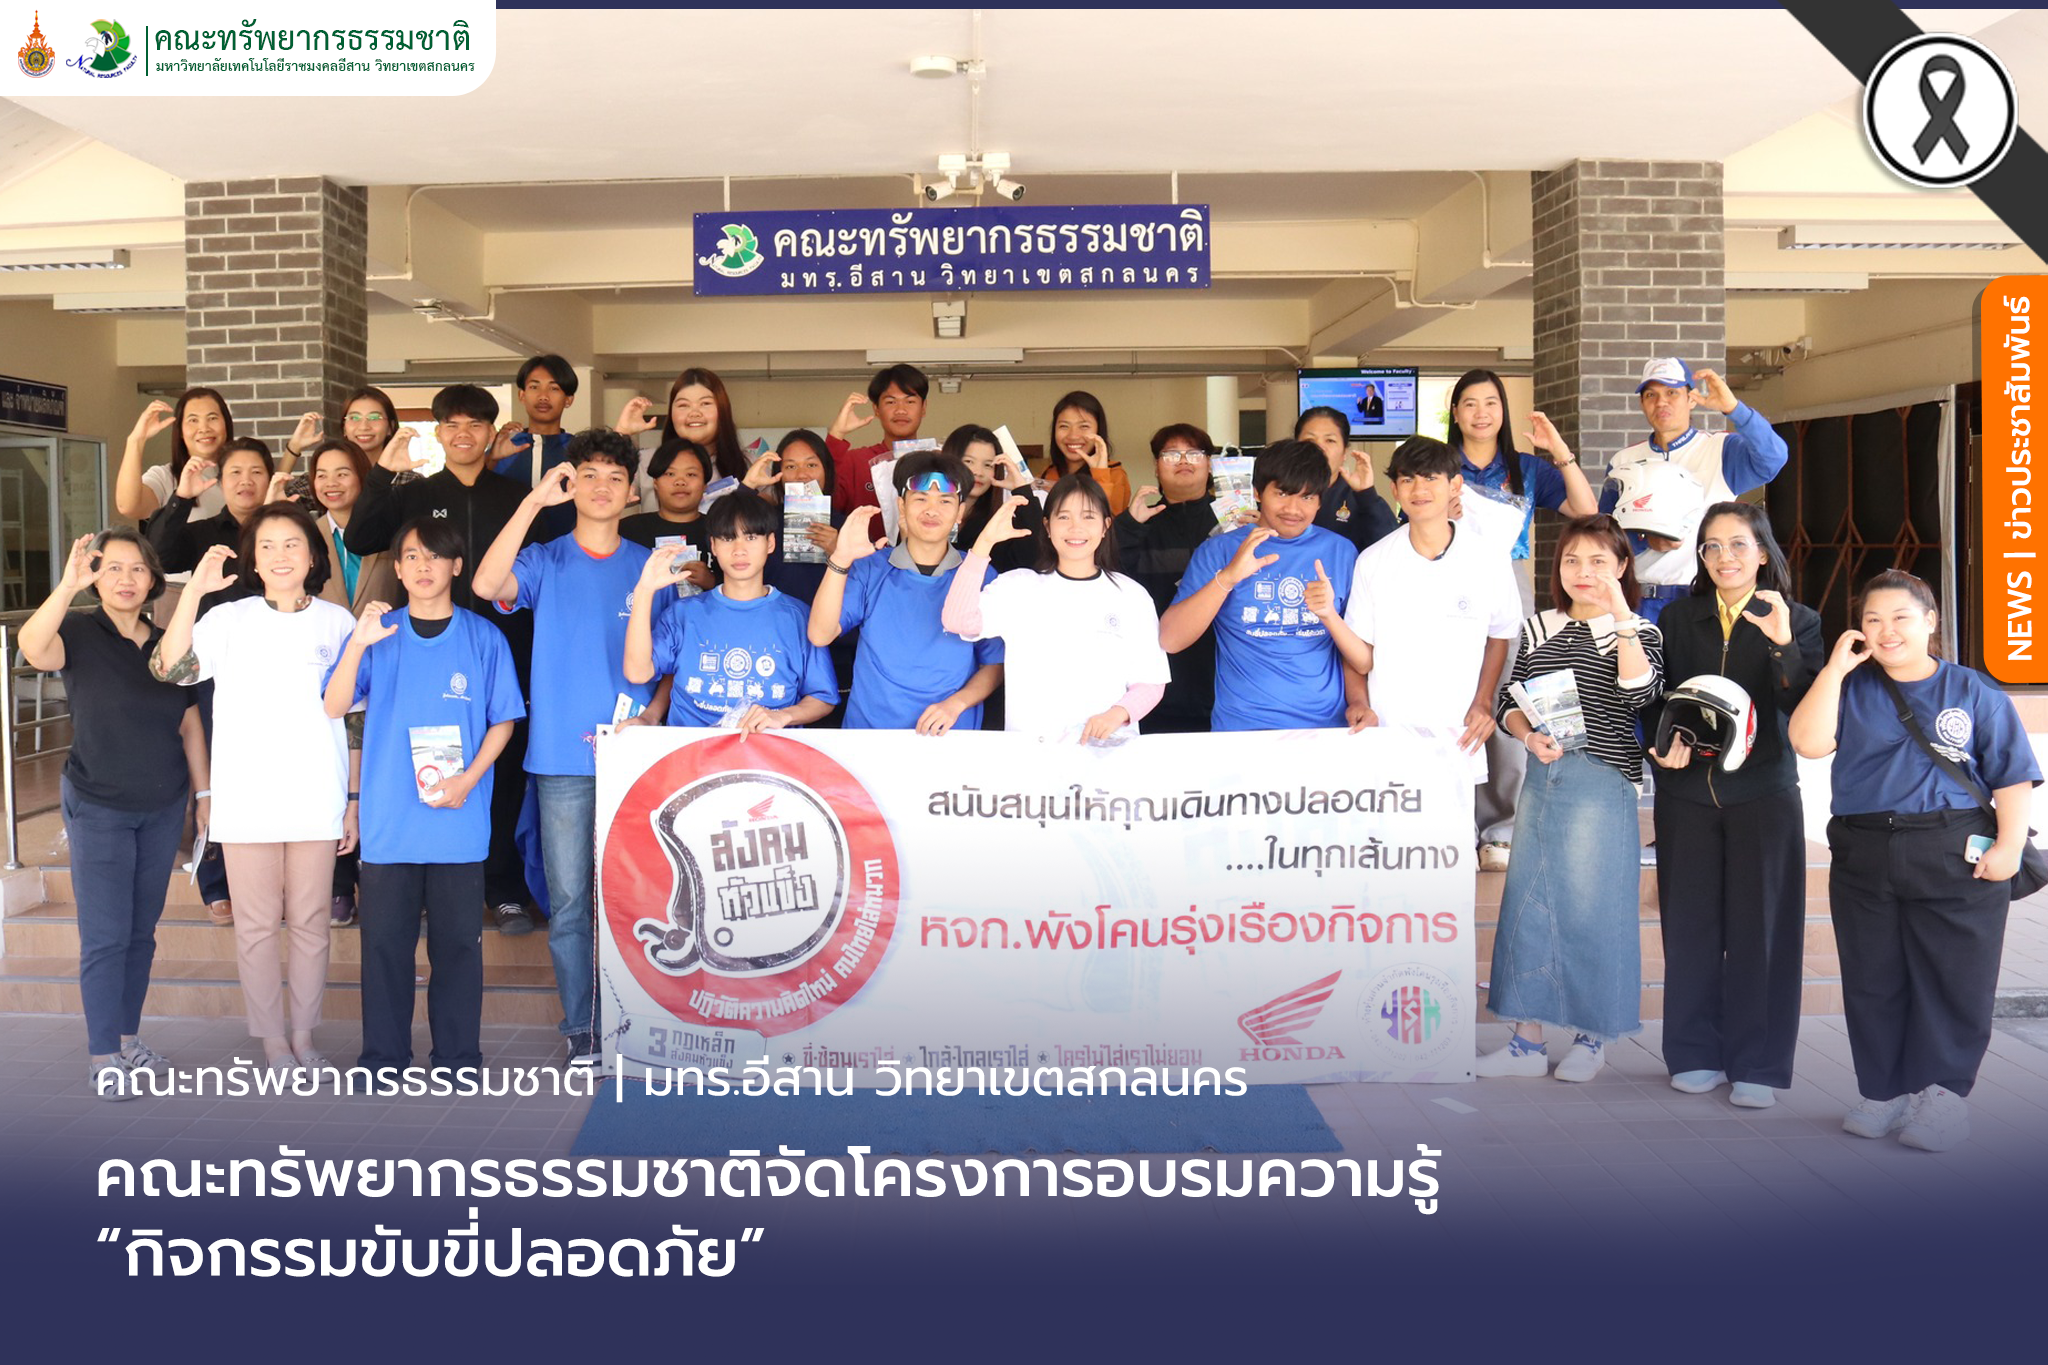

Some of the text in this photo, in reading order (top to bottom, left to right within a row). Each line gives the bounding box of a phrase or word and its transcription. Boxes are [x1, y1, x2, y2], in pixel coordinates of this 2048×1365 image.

[773, 207, 1203, 258] คณะทรัพยากรธรรมชาติ
[940, 263, 1198, 287] วิทยาเขตสกลนคร
[928, 781, 1422, 830] สนับสนุนให้คุณเดินทางปลอดภัย
[710, 820, 809, 872] สังคม
[717, 864, 819, 921] หัวแข็ง
[921, 901, 1459, 956] หจก.พังโคนรุ่งเรืองกิจการ
[648, 1026, 667, 1058] 3
[1239, 1046, 1346, 1062] HONDA
